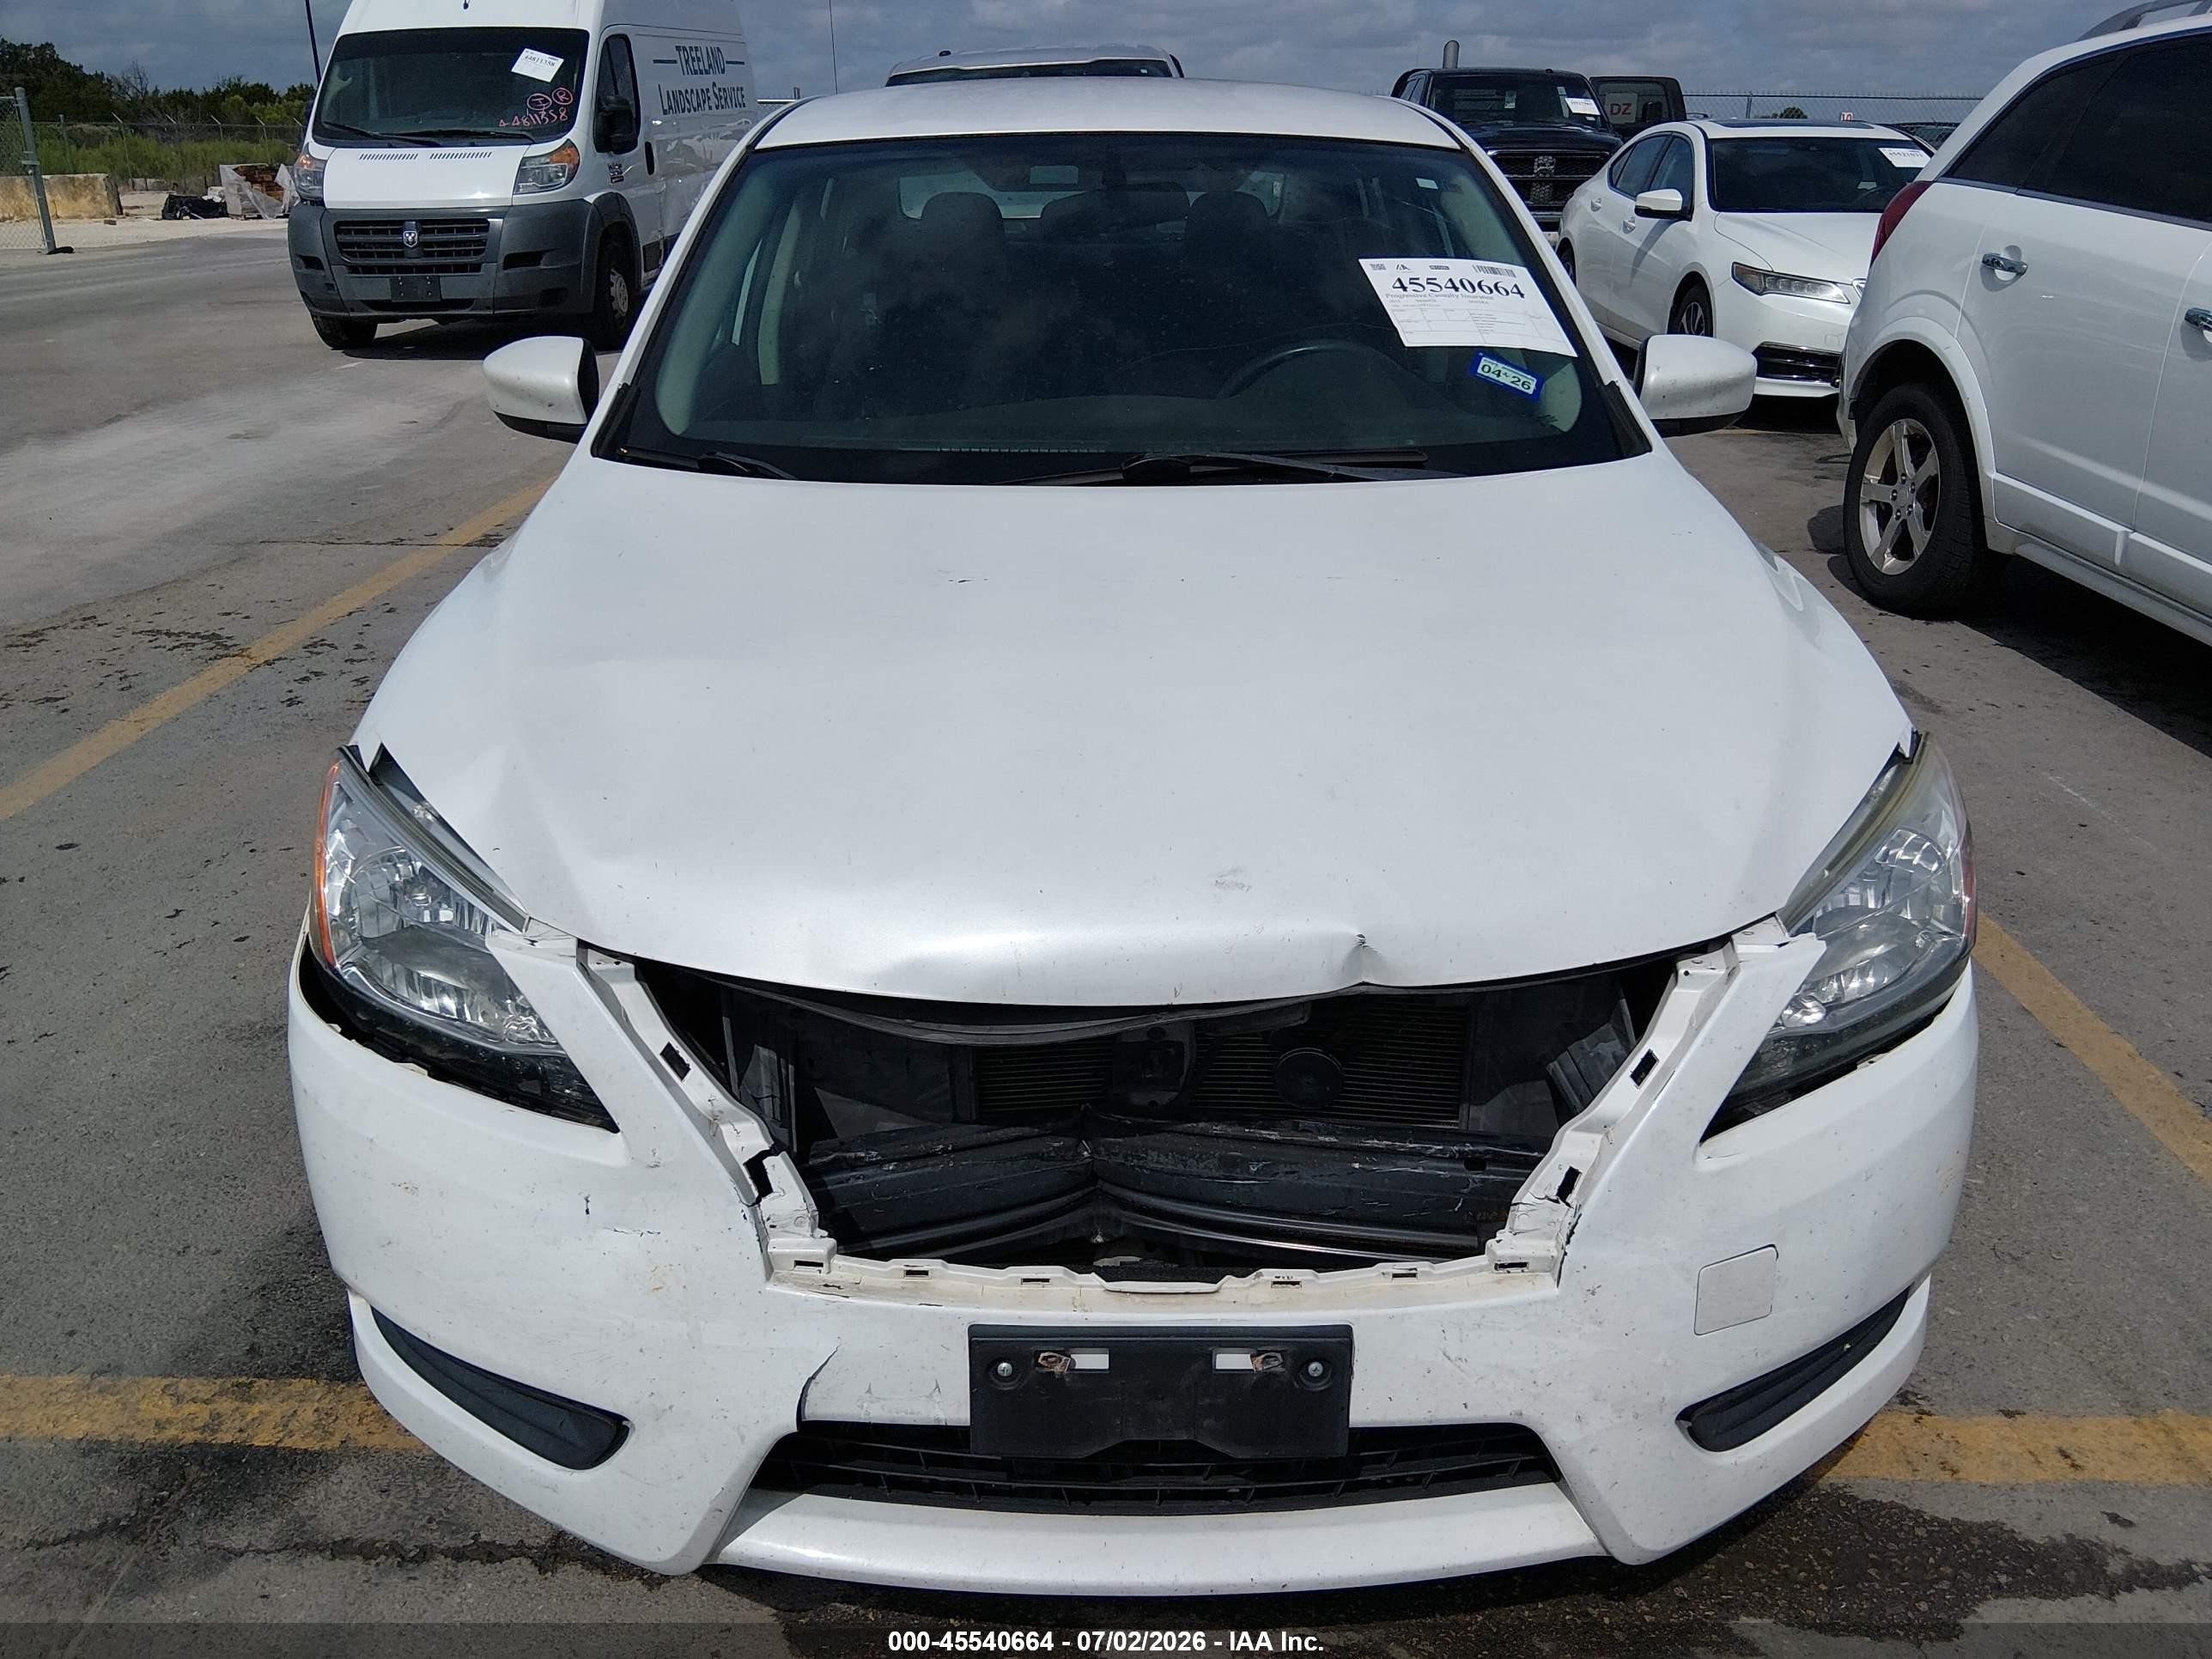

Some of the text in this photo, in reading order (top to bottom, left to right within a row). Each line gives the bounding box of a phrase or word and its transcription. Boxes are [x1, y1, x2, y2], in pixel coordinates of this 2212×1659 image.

[675, 46, 726, 76] TREELAND
[556, 89, 569, 102] R
[658, 82, 746, 116] LANDSCAPE SERVICE
[1392, 276, 1525, 299] 45540664
[1480, 364, 1532, 390] 04 26
